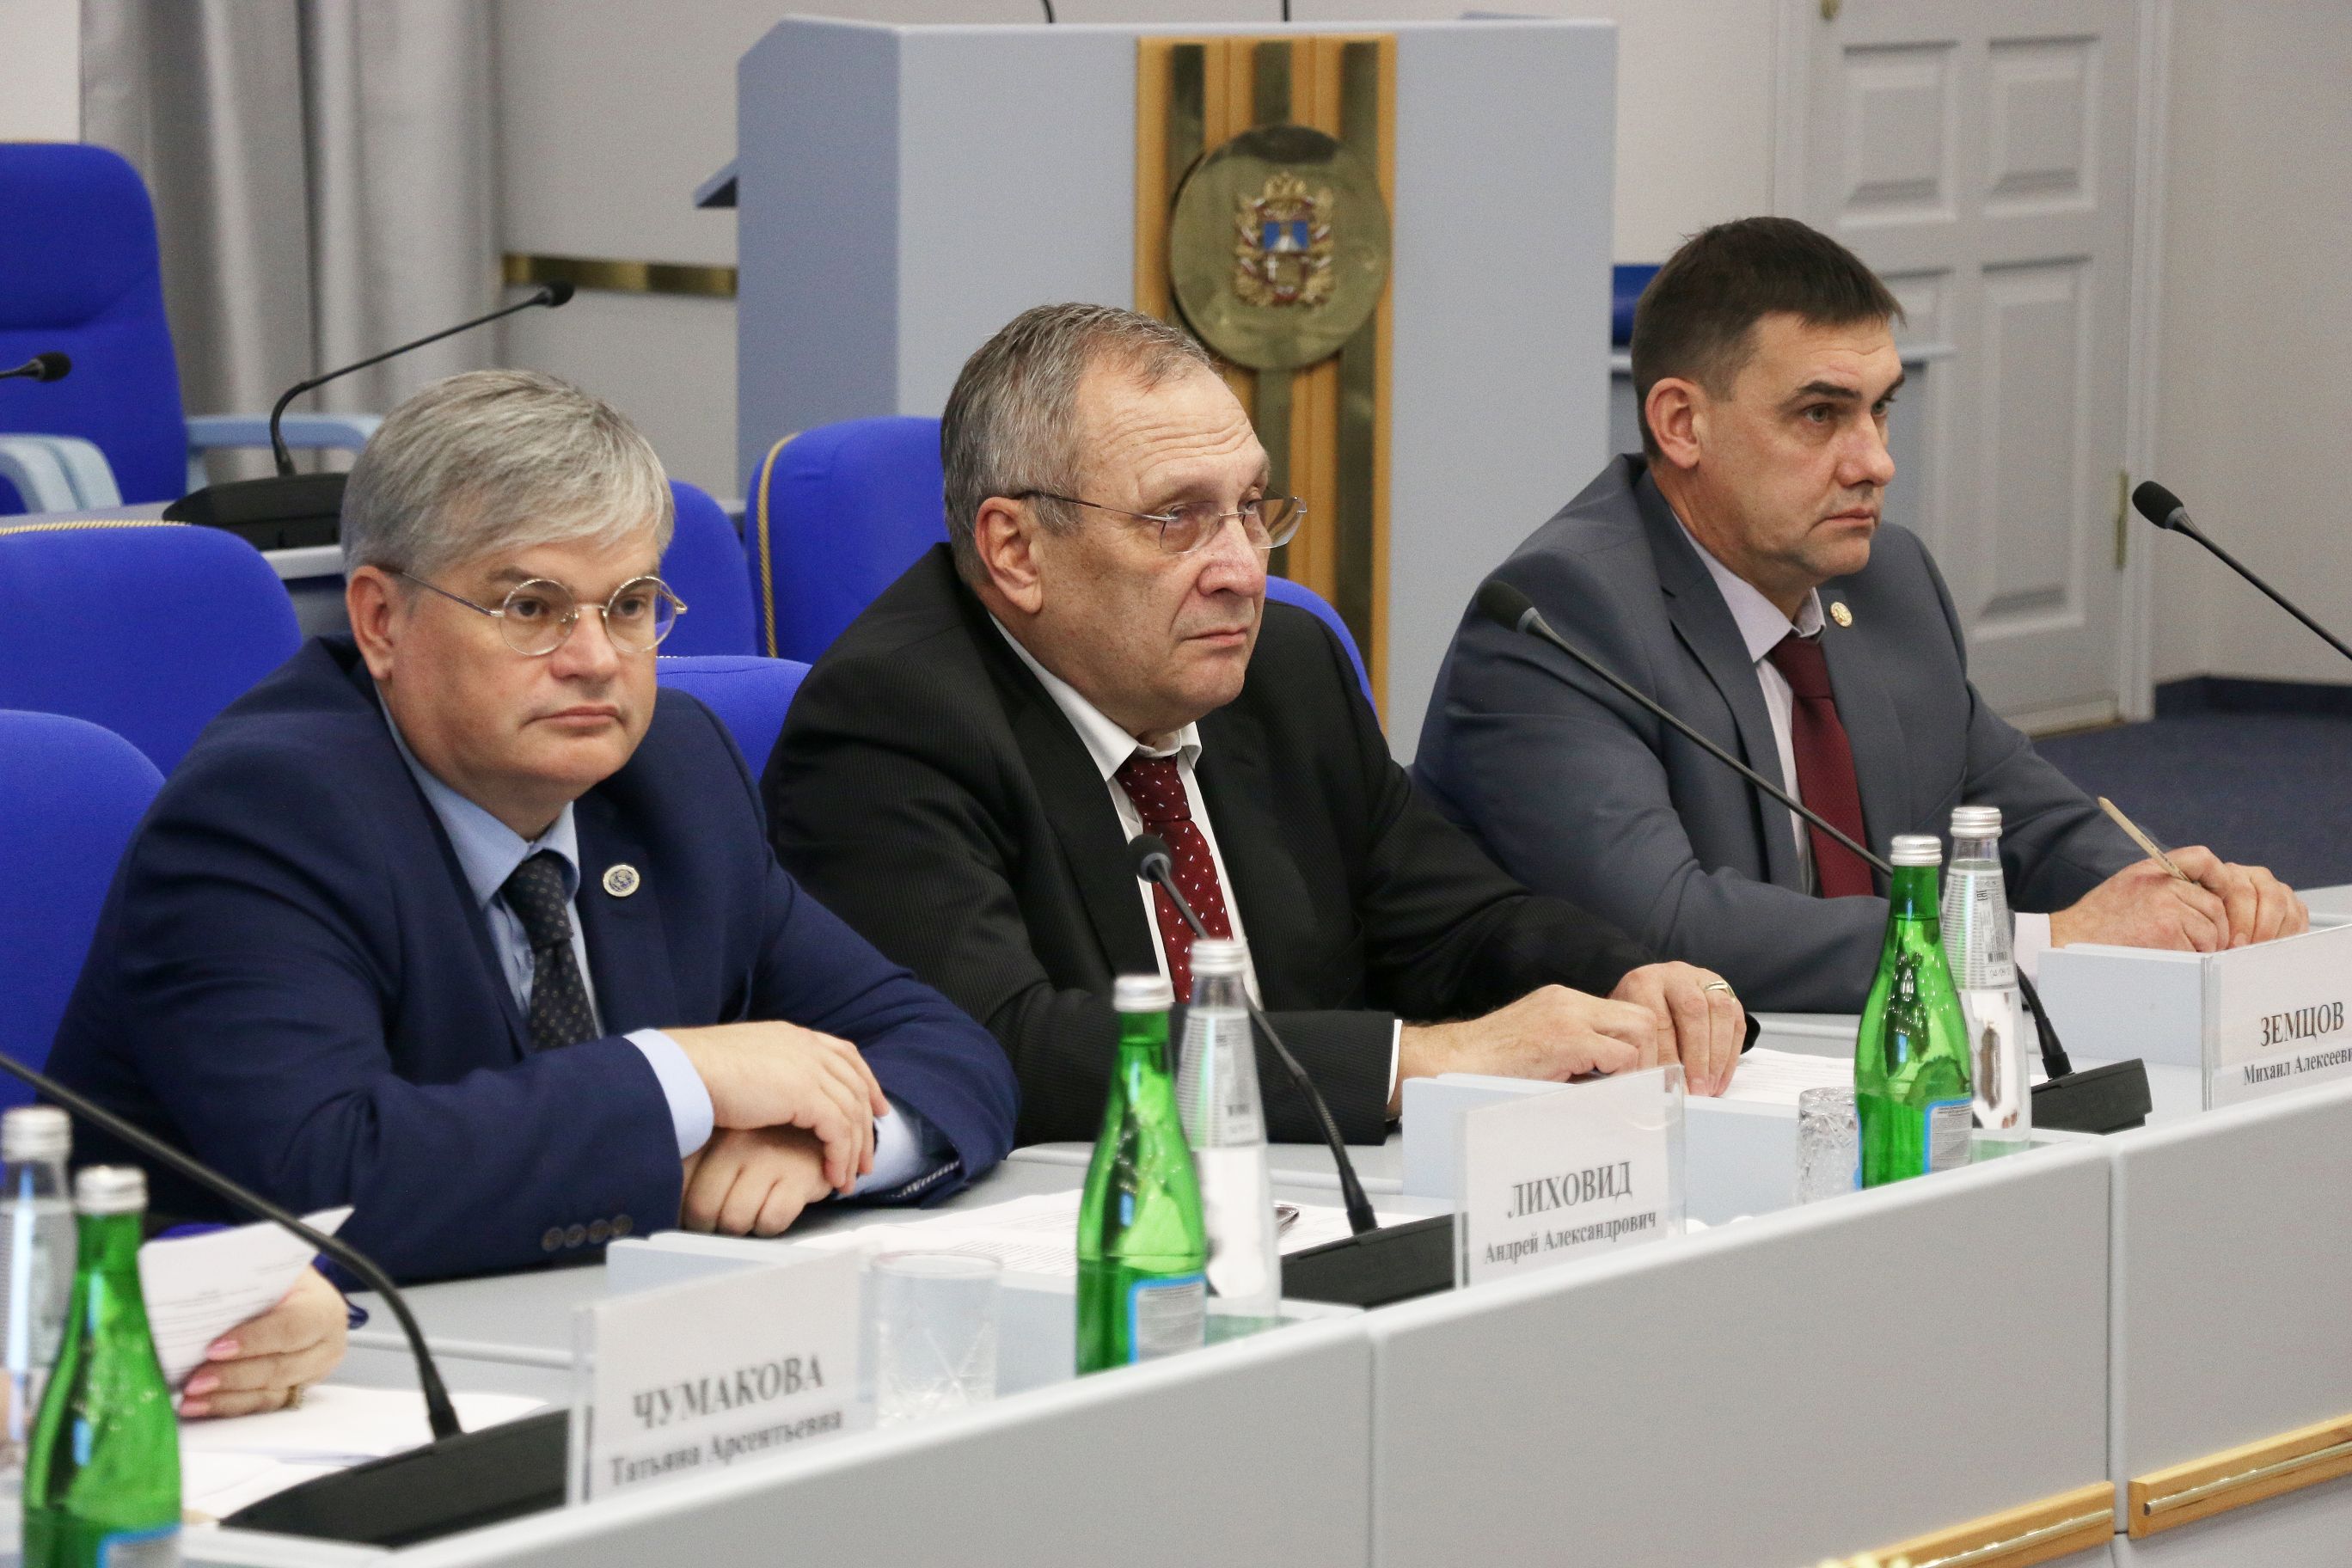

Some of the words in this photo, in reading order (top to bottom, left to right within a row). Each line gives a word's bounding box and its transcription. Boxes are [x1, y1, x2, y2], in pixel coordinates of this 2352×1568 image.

[2260, 1001, 2344, 1046] ЗЕМЦОВ
[2244, 1062, 2291, 1086] Михаил
[1507, 1161, 1632, 1218] ЛИХОВИД
[1485, 1232, 1540, 1265] Андрей
[1544, 1212, 1657, 1251] Александрович
[633, 1355, 824, 1428] ЧУМАКОВА
[609, 1446, 701, 1485] Татьяна
